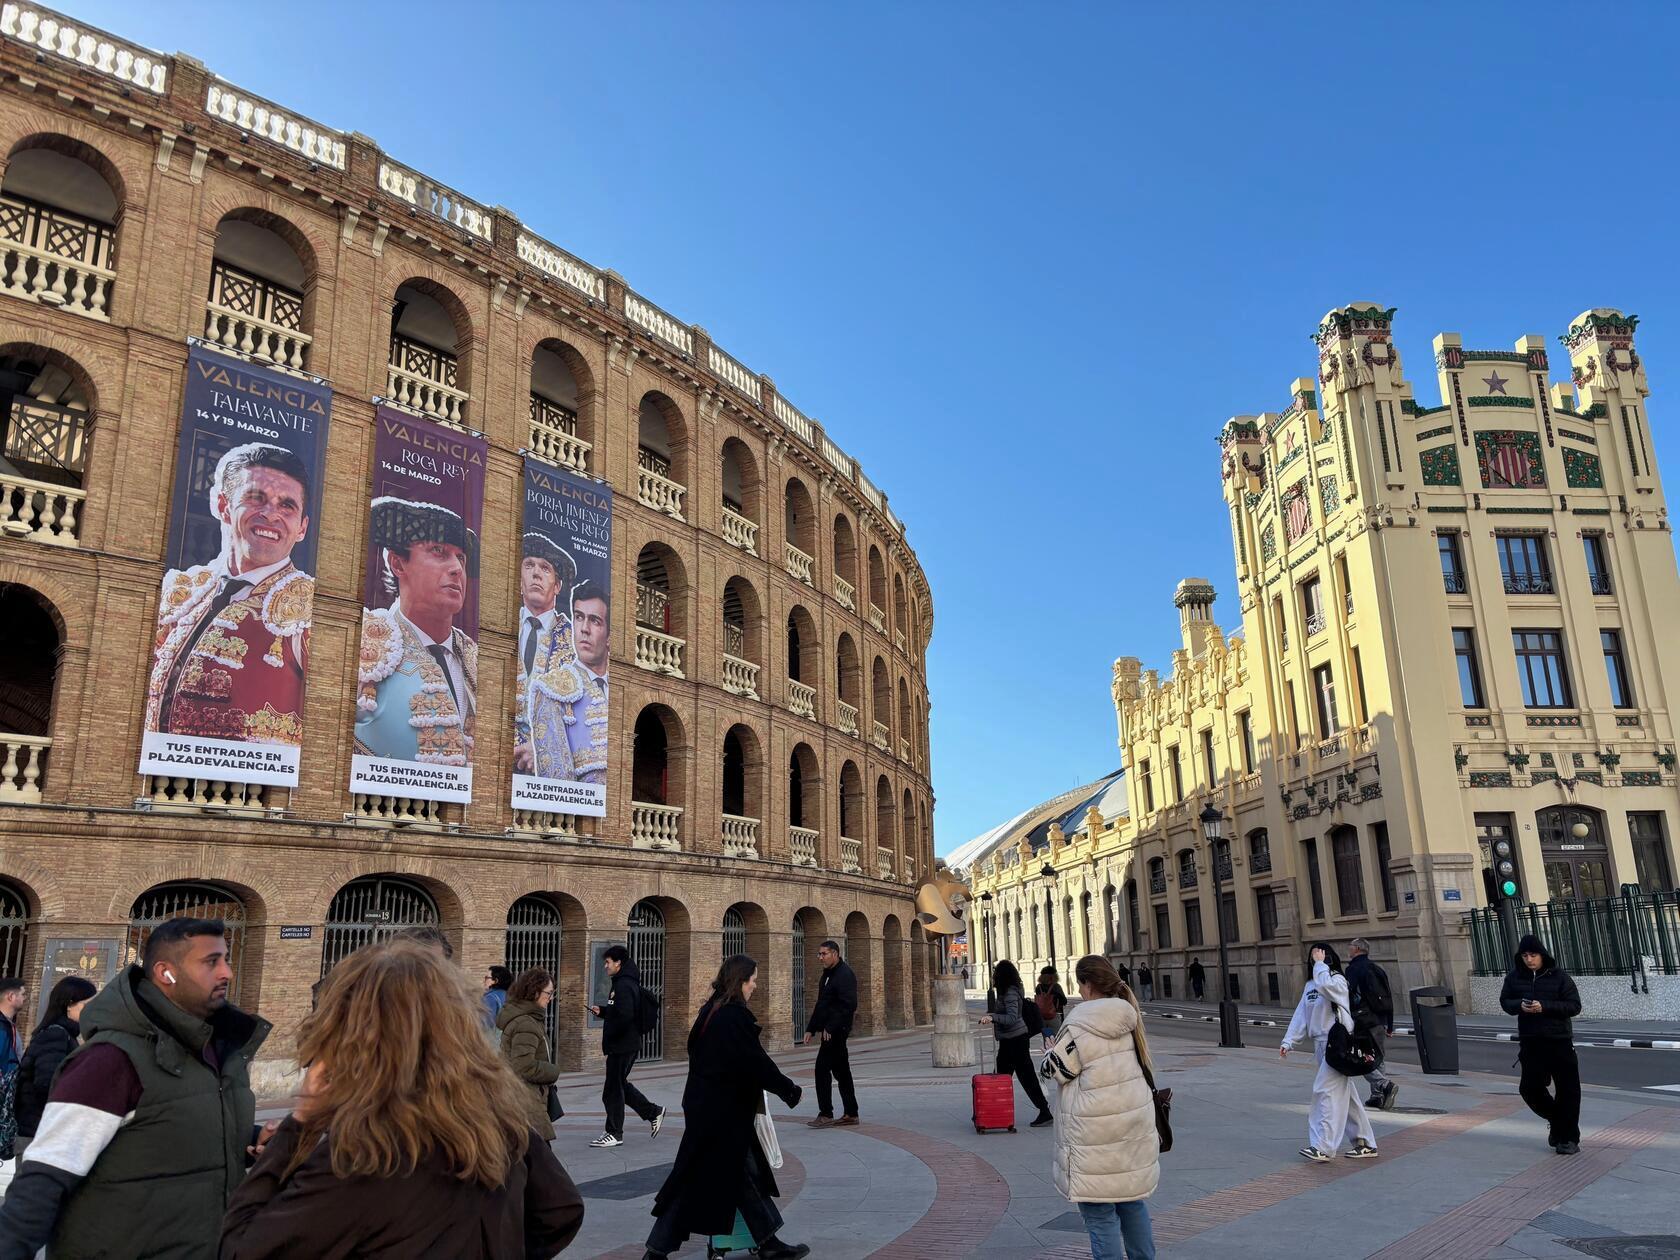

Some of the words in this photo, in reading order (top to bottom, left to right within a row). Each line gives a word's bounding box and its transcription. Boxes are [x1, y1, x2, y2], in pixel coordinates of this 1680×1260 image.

[197, 361, 325, 415] VALENCIA
[210, 390, 313, 434] TALAVANTE
[196, 408, 209, 420] 14
[212, 413, 221, 422] Y
[222, 416, 235, 426] 19
[237, 420, 280, 439] MARZO
[383, 419, 482, 466] VALENCIA
[381, 460, 392, 470] 14
[394, 464, 406, 475] DE
[408, 469, 442, 485] MARZO
[402, 448, 438, 472] ROCA
[442, 462, 469, 480] REY
[527, 489, 563, 512] BORJA
[530, 470, 609, 511] VALENCIA
[571, 535, 587, 544] MANO
[592, 542, 607, 551] MANO
[582, 522, 609, 542] RUFO
[573, 543, 581, 551] 18
[582, 546, 607, 559] MARZO
[148, 752, 295, 774] PLAZADEVALENCIA.ES
[166, 742, 191, 753] TUS
[195, 745, 262, 760] ENTRADAS
[265, 752, 282, 762] EN
[356, 773, 469, 792] PLAZADEVALENCIA.ES
[369, 764, 388, 773] TUS
[391, 767, 443, 779] ENTRADAS
[445, 772, 458, 780] EN
[516, 790, 604, 807] PLAZADEVALENCIA.ES
[526, 782, 541, 790] TUS
[543, 784, 584, 796] ENTRADAS
[585, 789, 595, 797] EN
